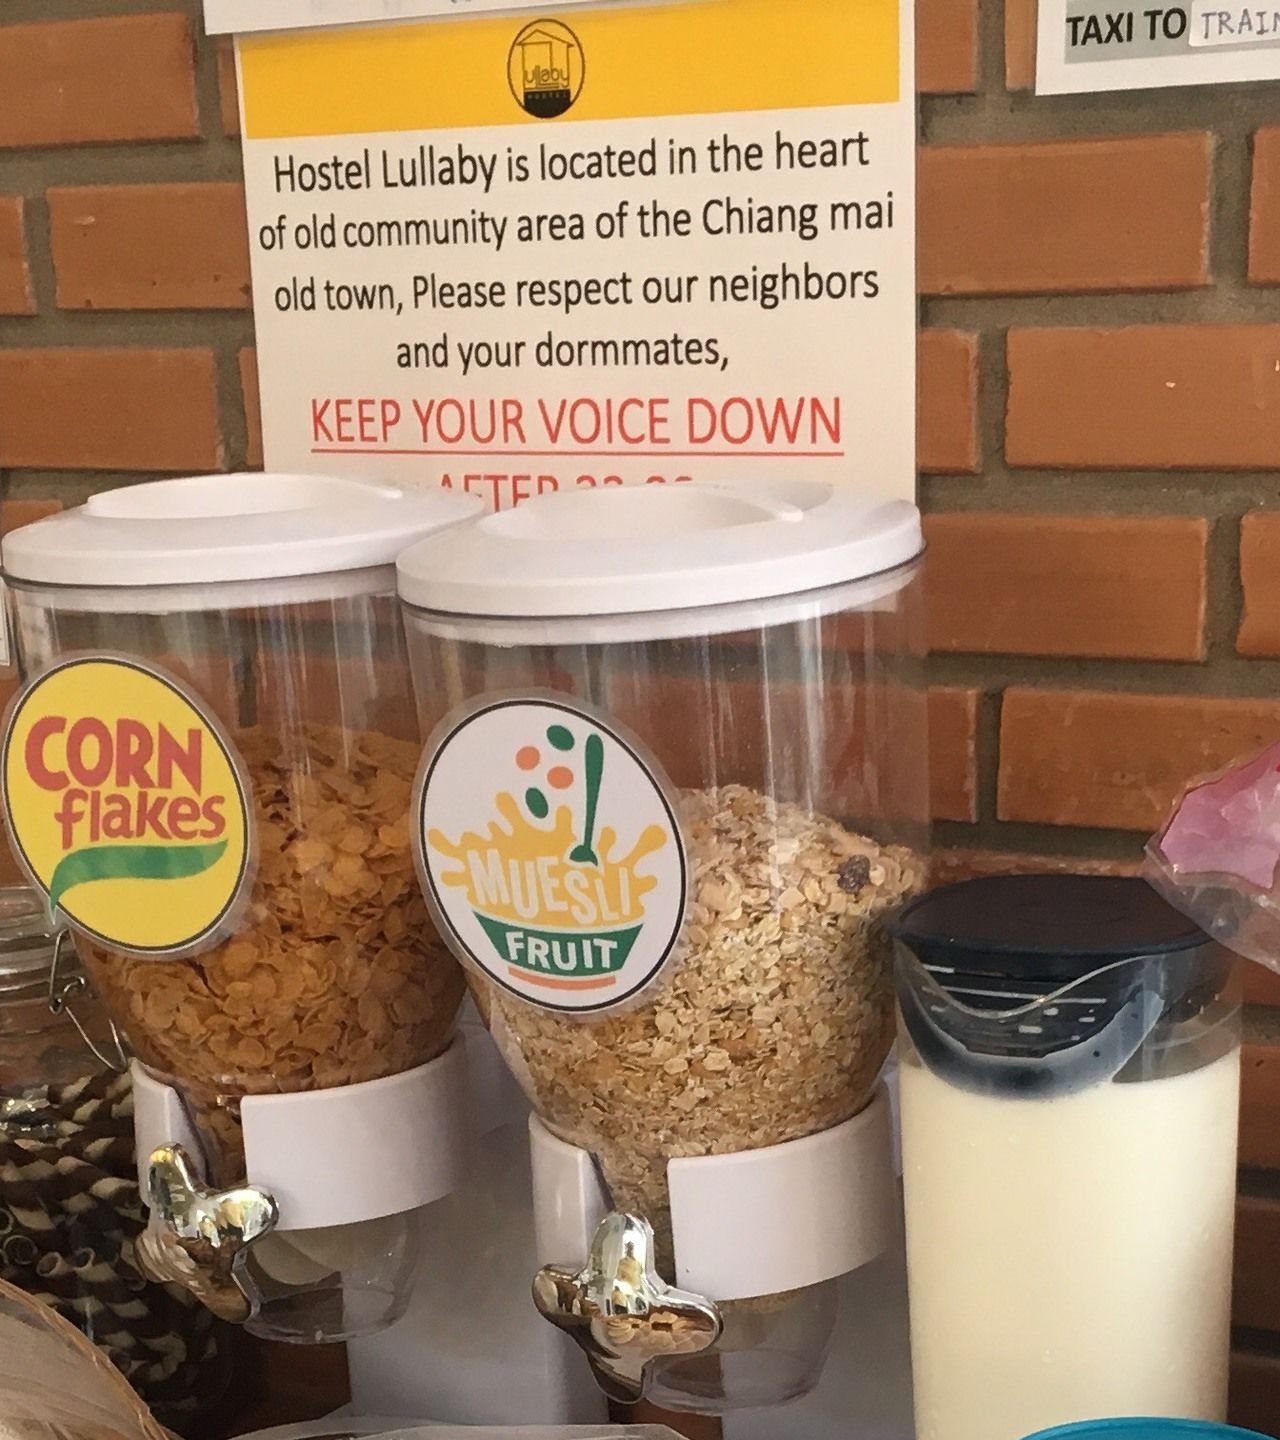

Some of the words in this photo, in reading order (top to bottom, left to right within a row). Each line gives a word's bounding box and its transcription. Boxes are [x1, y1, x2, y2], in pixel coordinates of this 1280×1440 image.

[1066, 12, 1133, 46] TAXI
[1144, 8, 1187, 40] TO
[273, 148, 371, 192] Hostel
[381, 144, 497, 192] Lullaby
[507, 146, 528, 183] is
[540, 140, 656, 181] located
[669, 140, 696, 176] in
[708, 137, 762, 173] the
[775, 131, 869, 170] heart
[259, 213, 288, 249] of
[295, 211, 337, 249] old
[343, 208, 507, 252] community
[517, 211, 585, 241] area
[595, 203, 629, 239] of
[638, 201, 691, 238] the
[702, 198, 818, 241] Chiang
[829, 191, 894, 230] mai
[275, 276, 315, 311] old
[324, 279, 403, 316] town,
[413, 274, 505, 309] Please
[517, 272, 632, 315] respect
[642, 276, 698, 303] our
[710, 261, 879, 310] neighbors
[397, 334, 448, 368] and
[458, 338, 525, 375] your
[536, 330, 729, 372] dormmates,
[312, 398, 401, 443] KEEP
[413, 398, 526, 444] YOUR
[538, 397, 671, 445] VOICE
[688, 397, 841, 445] DOWN
[25, 715, 203, 795] CORN
[54, 787, 226, 849] flakes
[467, 849, 631, 926] MUESLI
[506, 930, 618, 972] FRUIT
